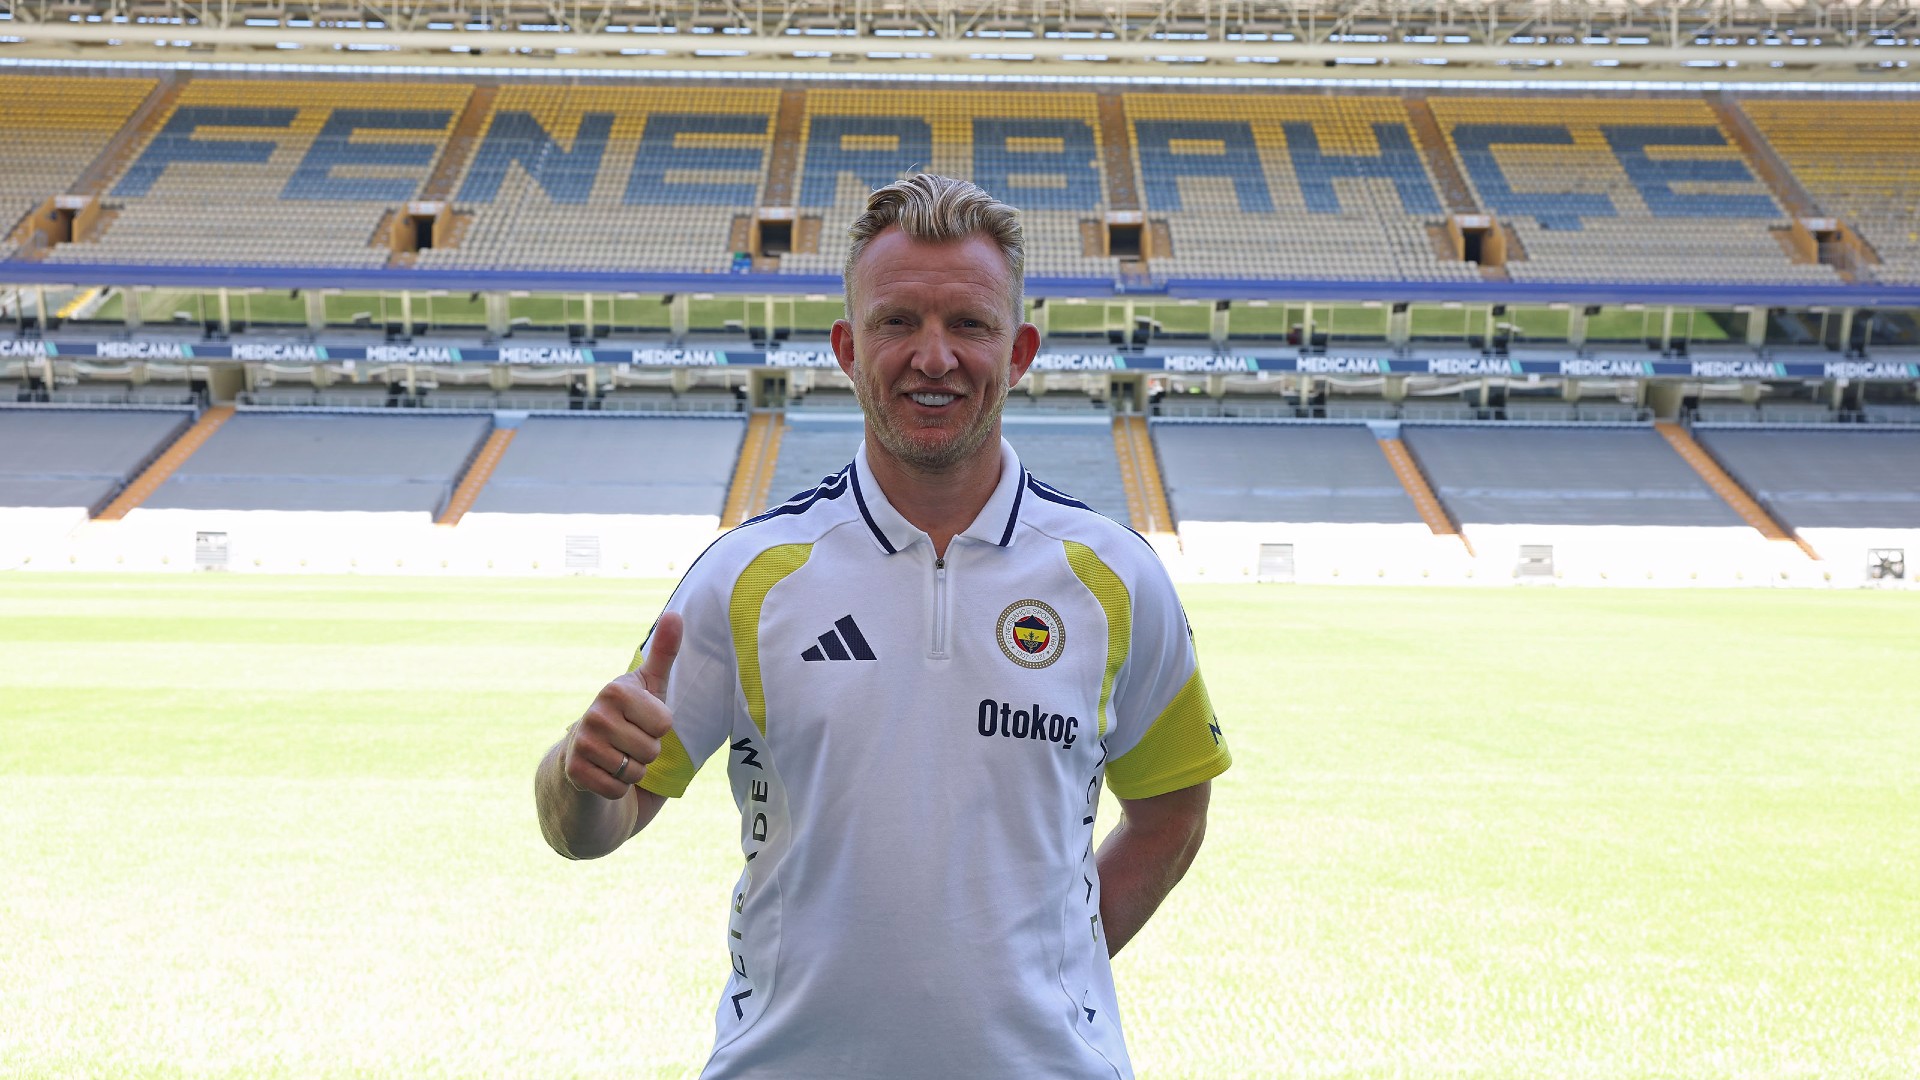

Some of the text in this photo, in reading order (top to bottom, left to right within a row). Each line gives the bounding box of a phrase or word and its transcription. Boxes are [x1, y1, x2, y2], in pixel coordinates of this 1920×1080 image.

[110, 104, 1785, 231] FENERBAHÇE
[0, 340, 47, 357] CANA
[96, 341, 183, 358] MEDICANA
[231, 344, 317, 360] MEDICANA
[366, 346, 450, 362] MEDICANA
[499, 347, 583, 363] MEDICANA
[632, 349, 717, 365] MEDICANA
[766, 351, 838, 366] MEDICAN
[1164, 355, 1248, 371] MEDICANA
[1296, 357, 1380, 373] MEDICANA
[1428, 359, 1512, 375] MEDICANA
[1560, 360, 1643, 376] MEDICANA
[1691, 361, 1776, 377] MEDICANA
[1824, 362, 1909, 378] MEDICANA
[978, 698, 1079, 750] Otokoç
